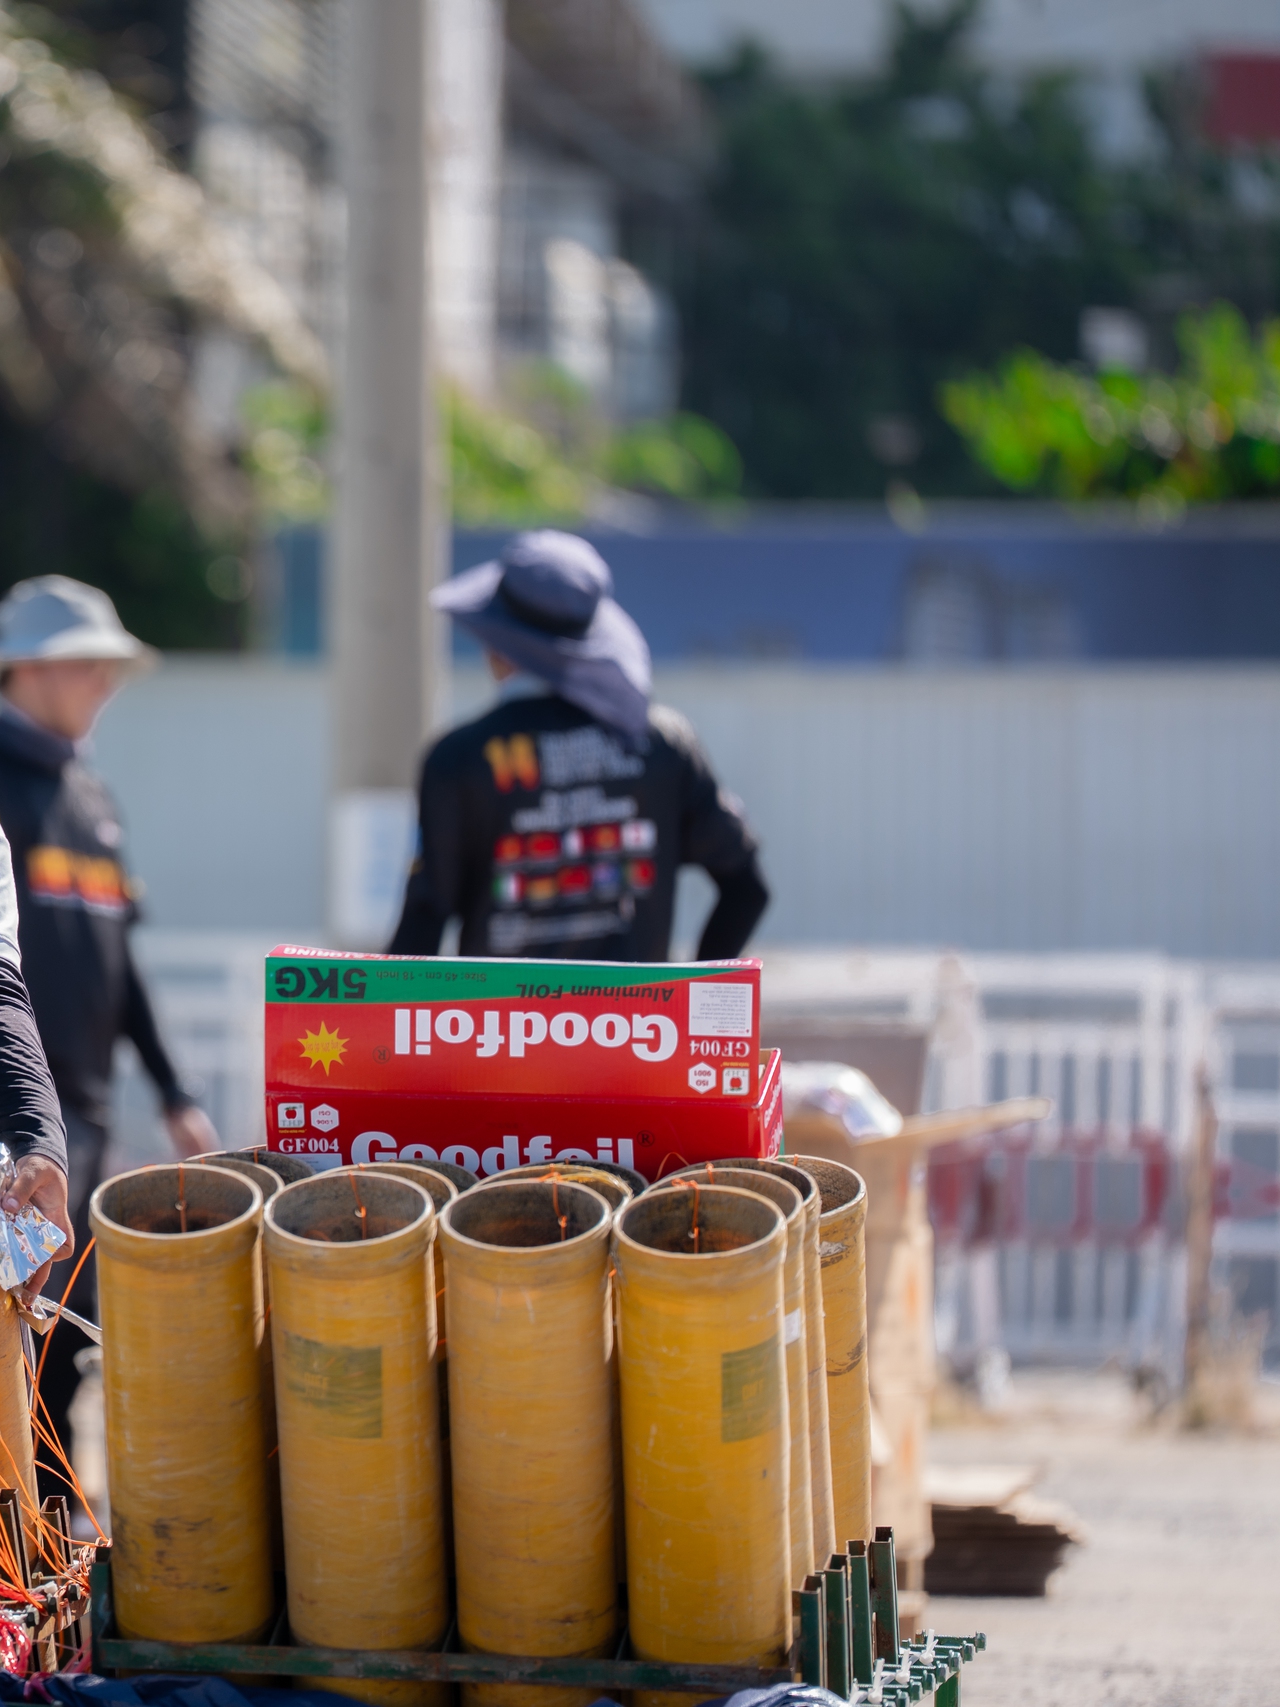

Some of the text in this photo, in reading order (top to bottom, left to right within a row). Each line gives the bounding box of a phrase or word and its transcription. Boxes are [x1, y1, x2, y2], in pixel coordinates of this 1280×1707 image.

[376, 970, 400, 980] inch
[402, 971, 416, 981] 18
[425, 972, 441, 981] cm
[444, 972, 457, 982] 45
[460, 972, 487, 983] Size:
[275, 966, 367, 1000] 5KG
[516, 983, 675, 1002] Aluminum FOIL
[394, 1008, 679, 1062] Goodfoil
[689, 1039, 750, 1058] GF004
[695, 1079, 709, 1087] ISO
[278, 1137, 339, 1153] GF004
